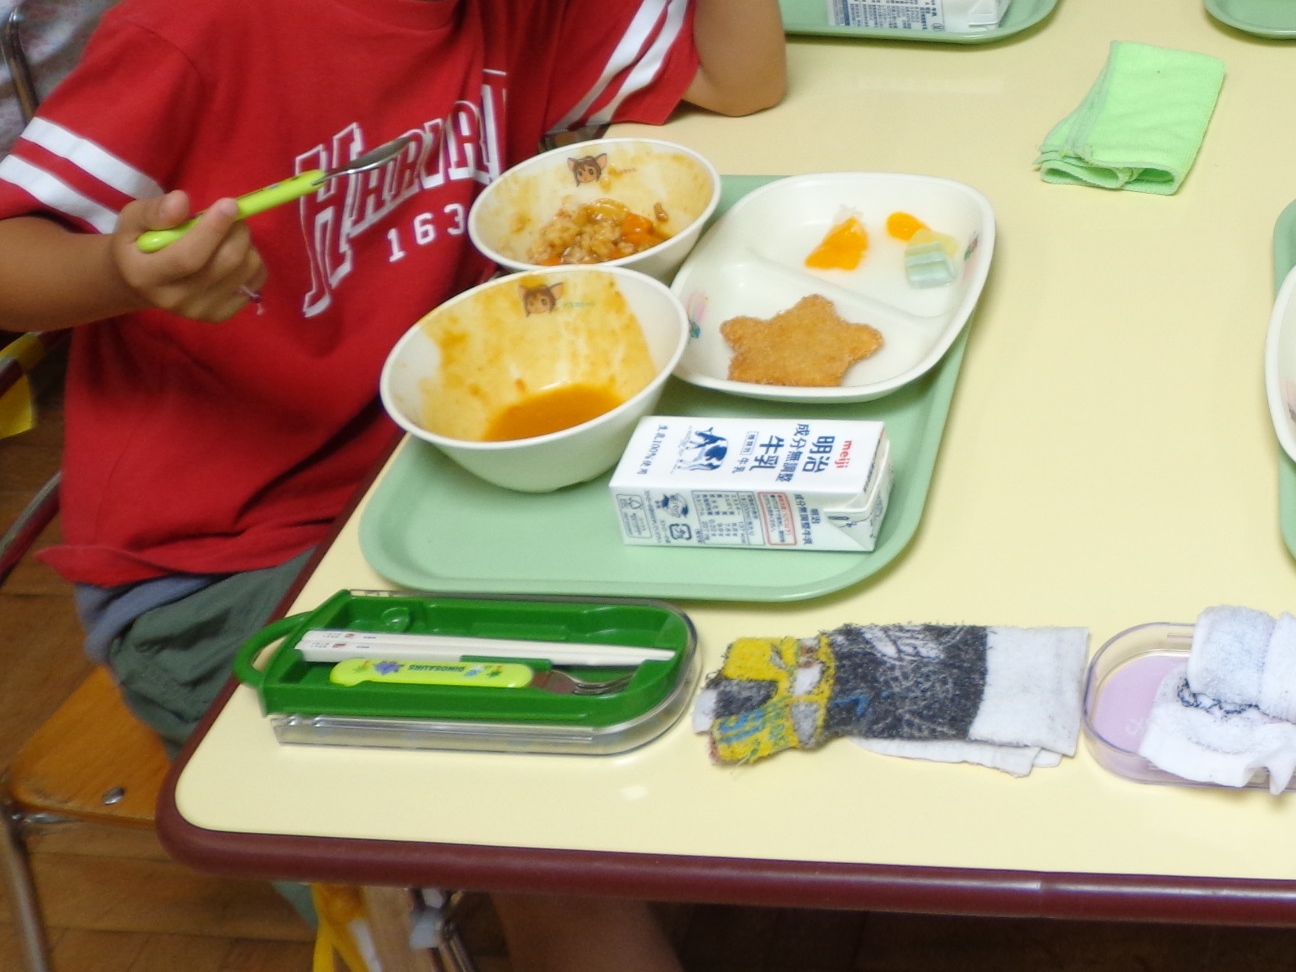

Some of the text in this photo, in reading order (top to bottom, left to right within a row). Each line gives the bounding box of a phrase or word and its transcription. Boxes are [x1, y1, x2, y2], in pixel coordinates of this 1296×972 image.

[636, 424, 669, 476] 生乳100%使用
[749, 434, 785, 471] 牛乳
[774, 422, 811, 483] 成分無調整
[802, 434, 836, 474] 明治
[834, 439, 853, 469] meiji
[811, 508, 821, 524] 明治
[408, 663, 465, 673] DINOSAURS
